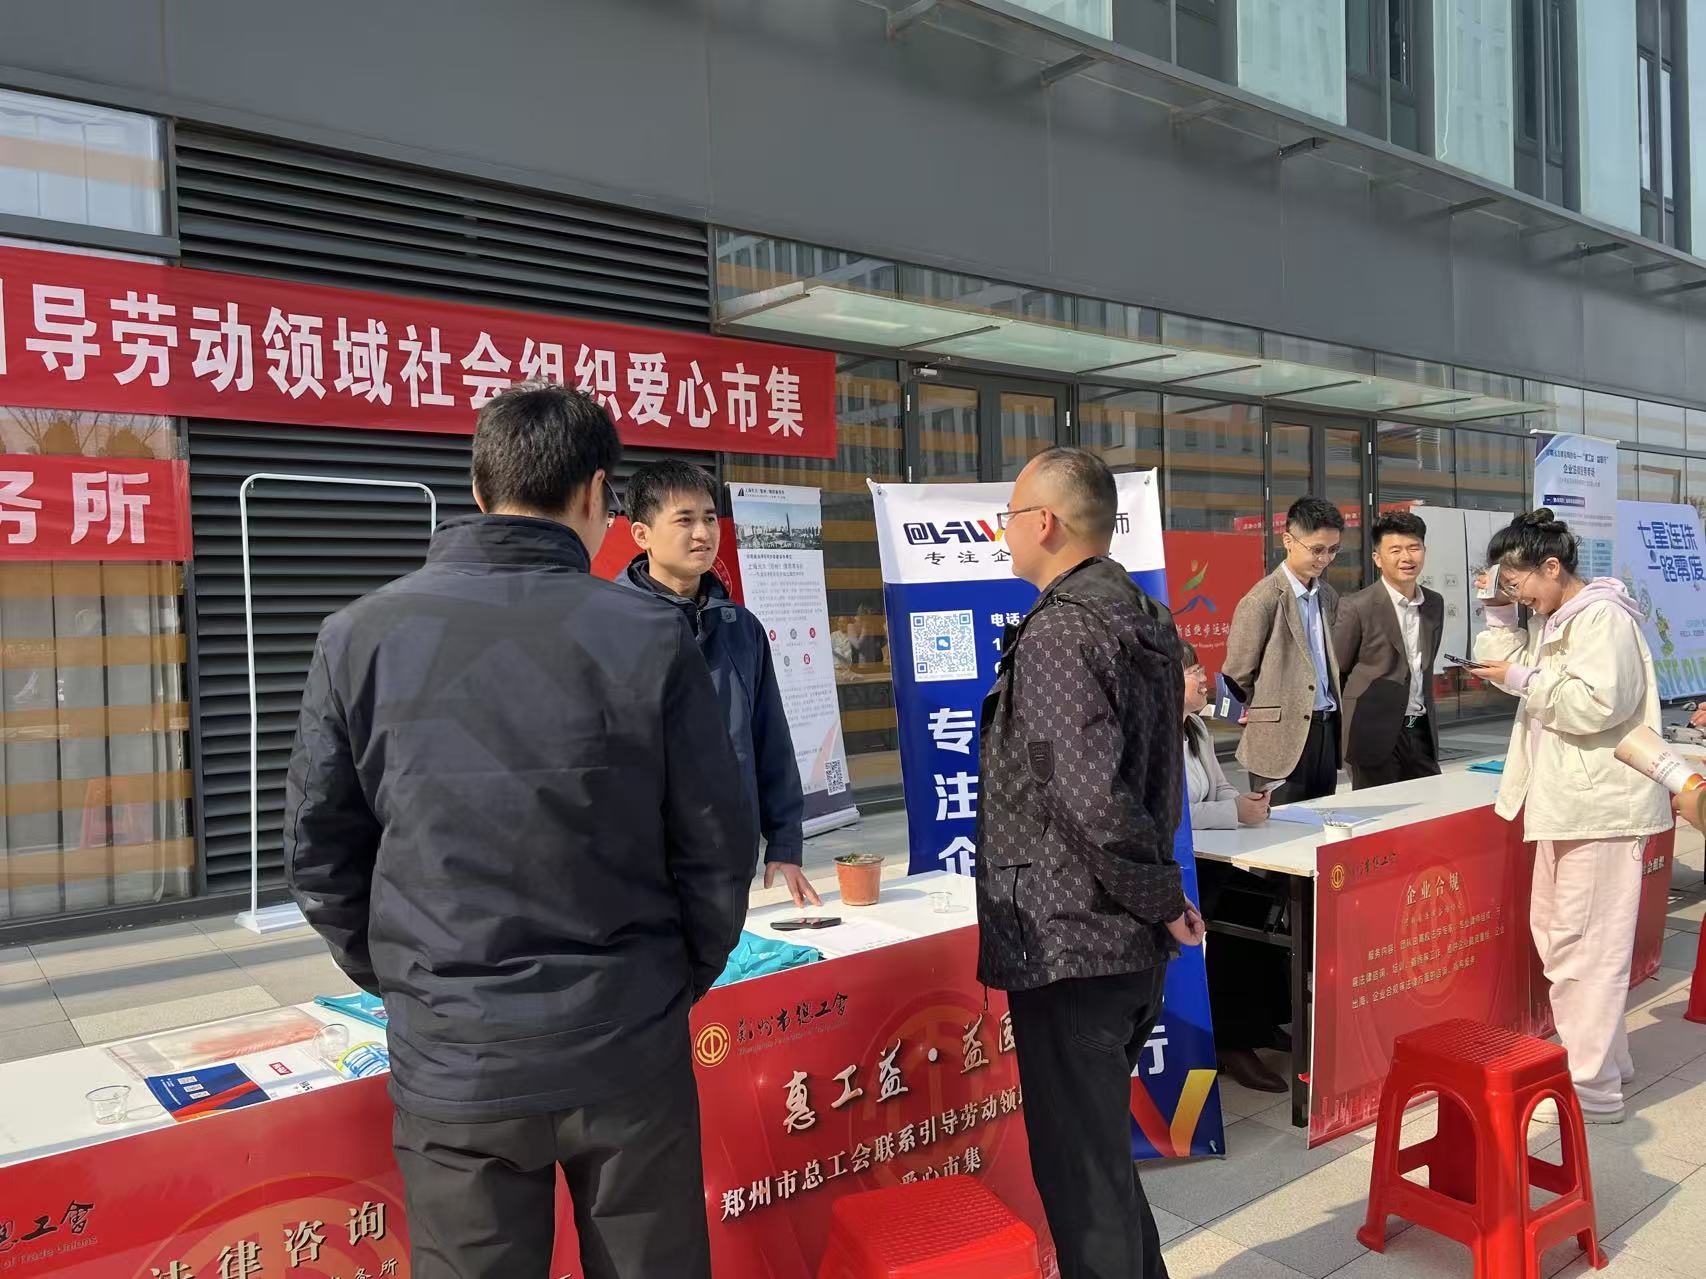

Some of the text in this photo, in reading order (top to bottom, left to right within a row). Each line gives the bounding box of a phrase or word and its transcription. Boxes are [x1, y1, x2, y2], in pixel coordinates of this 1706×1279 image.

[0, 278, 805, 438] 导劳动领域社会组织爱心市集
[1407, 871, 1461, 905] 企业合规
[57, 1235, 98, 1254] Unions
